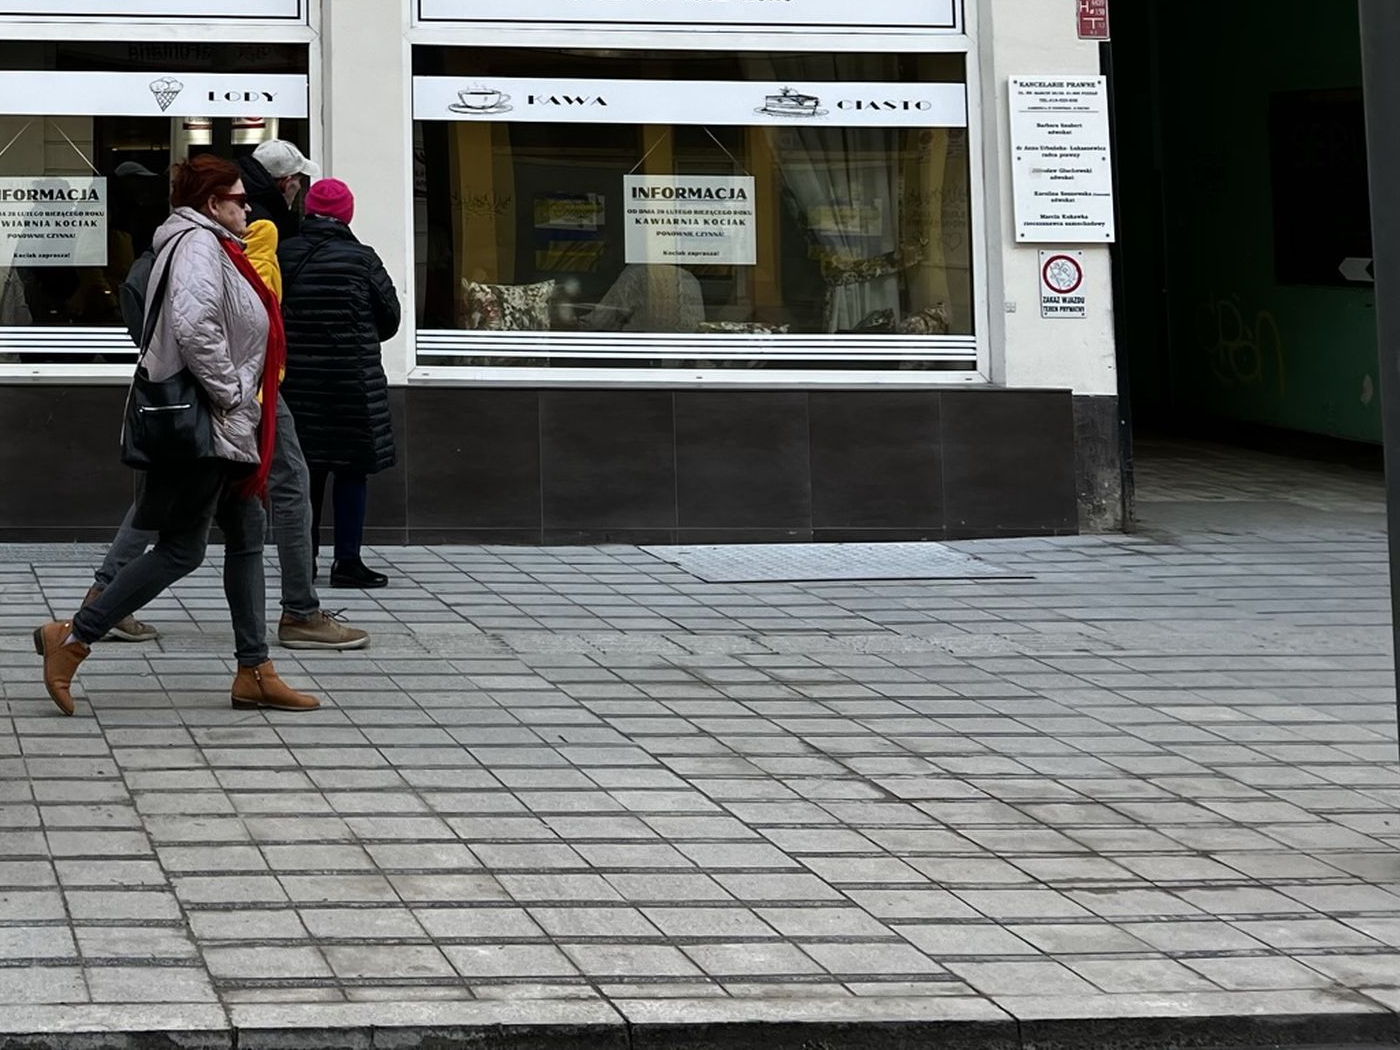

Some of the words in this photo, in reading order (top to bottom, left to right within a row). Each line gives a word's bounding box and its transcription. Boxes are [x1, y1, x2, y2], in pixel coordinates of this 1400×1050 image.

[208, 90, 278, 103] LODY
[527, 94, 608, 107] KAWA
[836, 99, 932, 111] CIASTO
[631, 186, 747, 200] INFORMACJA
[703, 218, 746, 226] KOCIAK
